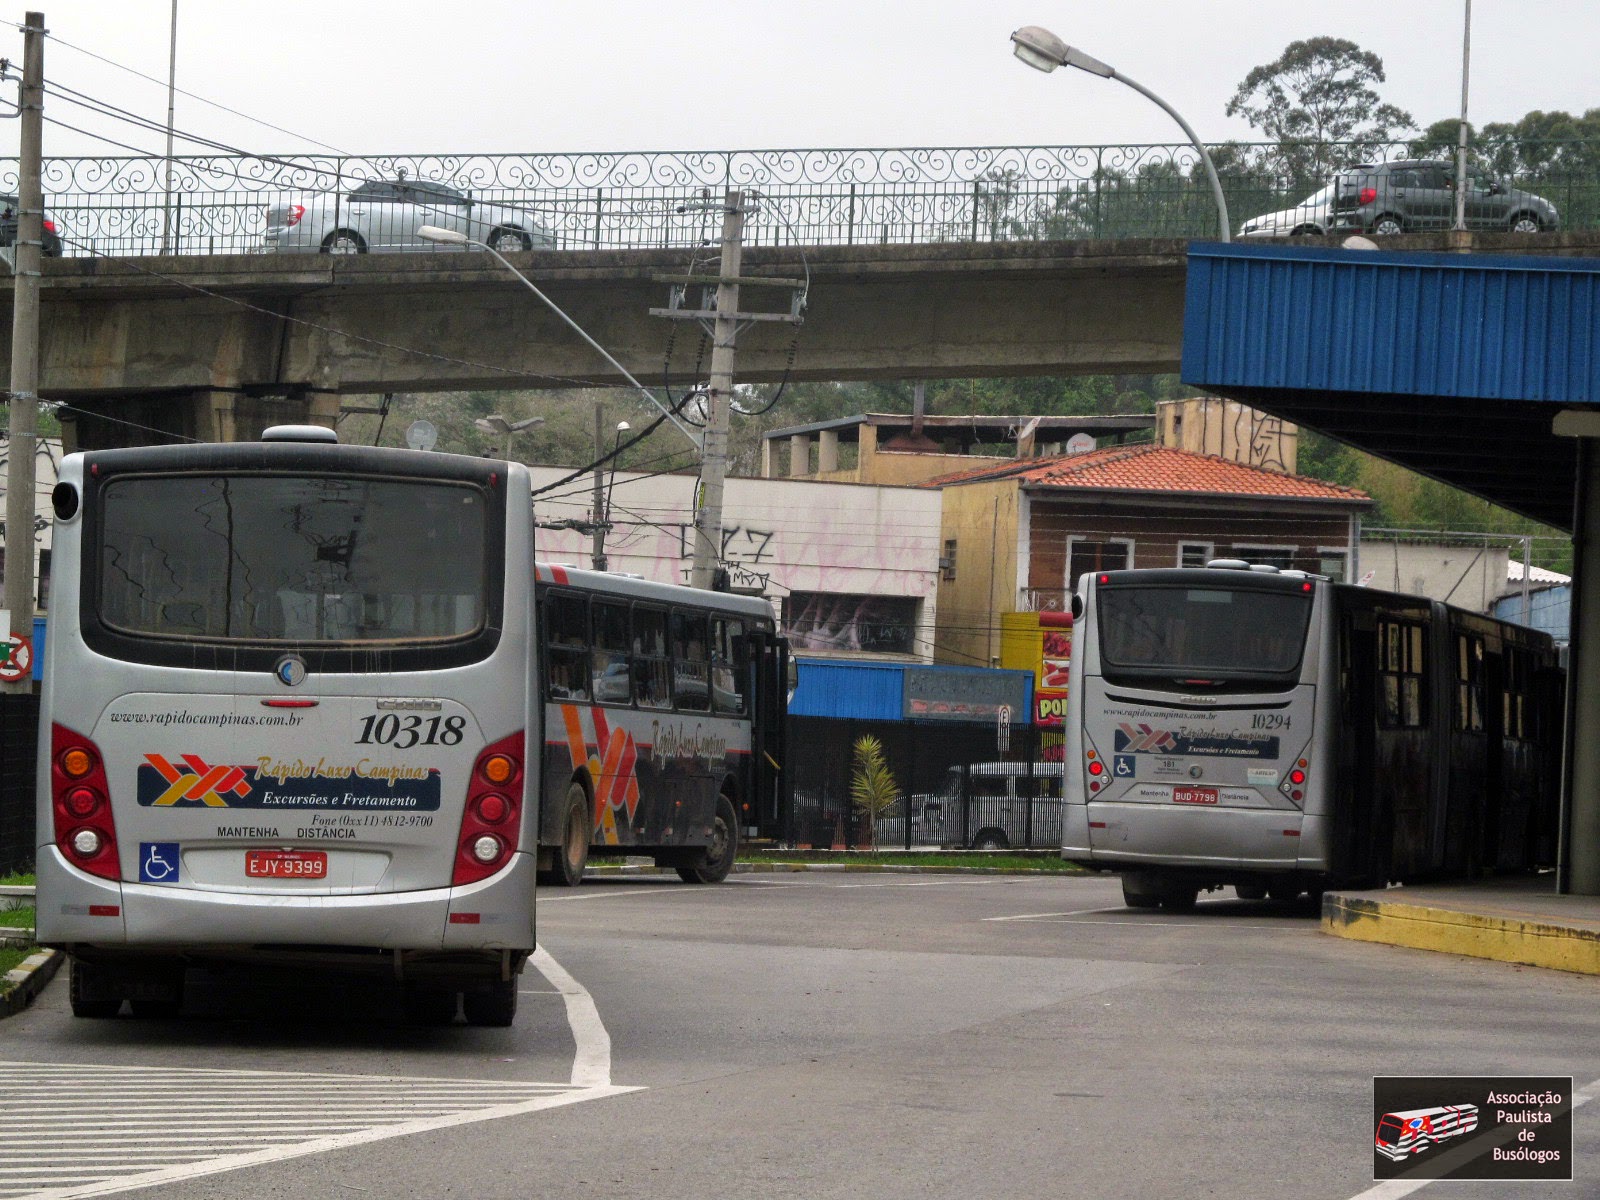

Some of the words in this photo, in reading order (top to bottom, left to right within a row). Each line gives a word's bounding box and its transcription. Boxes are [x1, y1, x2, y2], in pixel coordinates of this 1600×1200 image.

[110, 710, 304, 727] www.rapidocampinas.com.br
[1103, 708, 1218, 721] www.rapidocampinas.com.br
[1251, 713, 1292, 730] 10294
[354, 713, 466, 749] 10318
[1231, 729, 1271, 744] Campinas
[1187, 745, 1219, 754] Excursões
[1226, 747, 1260, 756] Fretamento
[254, 756, 310, 785] Rápido
[312, 757, 350, 778] Luxo
[354, 758, 429, 787] Campinas
[262, 791, 328, 805] Excursões
[331, 796, 338, 805] e
[343, 793, 417, 806] Fretamento
[311, 814, 337, 826] Fone
[339, 815, 379, 827] (0xx11)
[381, 815, 433, 827] 4812-9700
[217, 827, 279, 838] MANTENHA
[297, 826, 356, 839] DISTÂNCIA
